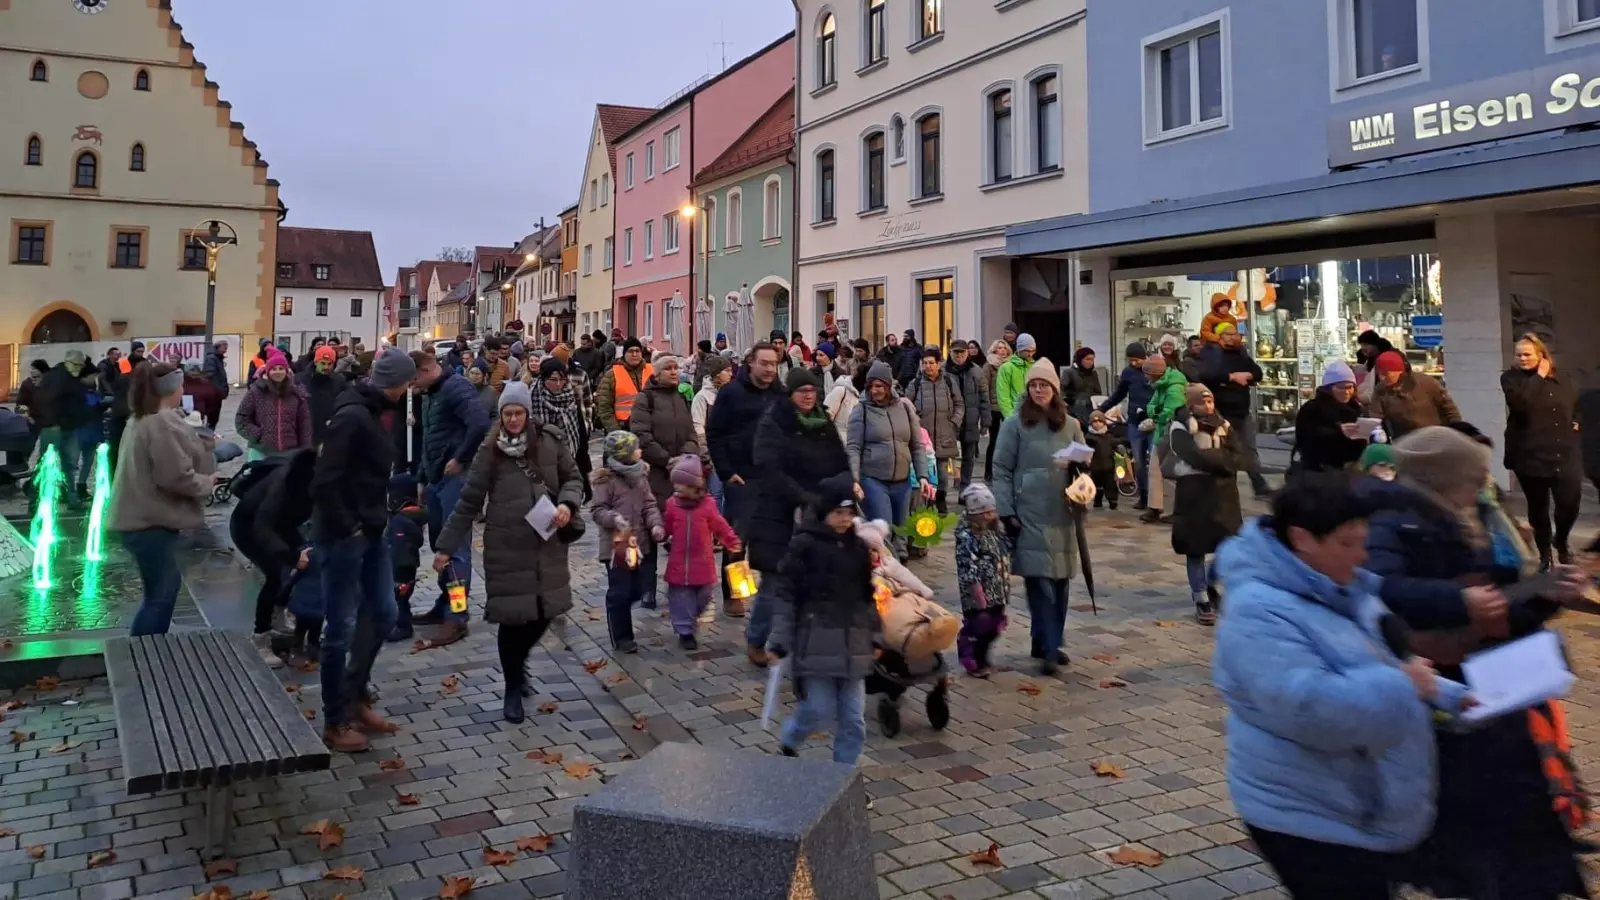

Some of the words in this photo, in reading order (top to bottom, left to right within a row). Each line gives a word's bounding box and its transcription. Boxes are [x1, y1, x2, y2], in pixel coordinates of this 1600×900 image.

[1349, 112, 1395, 143] WM
[1413, 92, 1533, 140] Eisen
[1545, 72, 1600, 114] Sc
